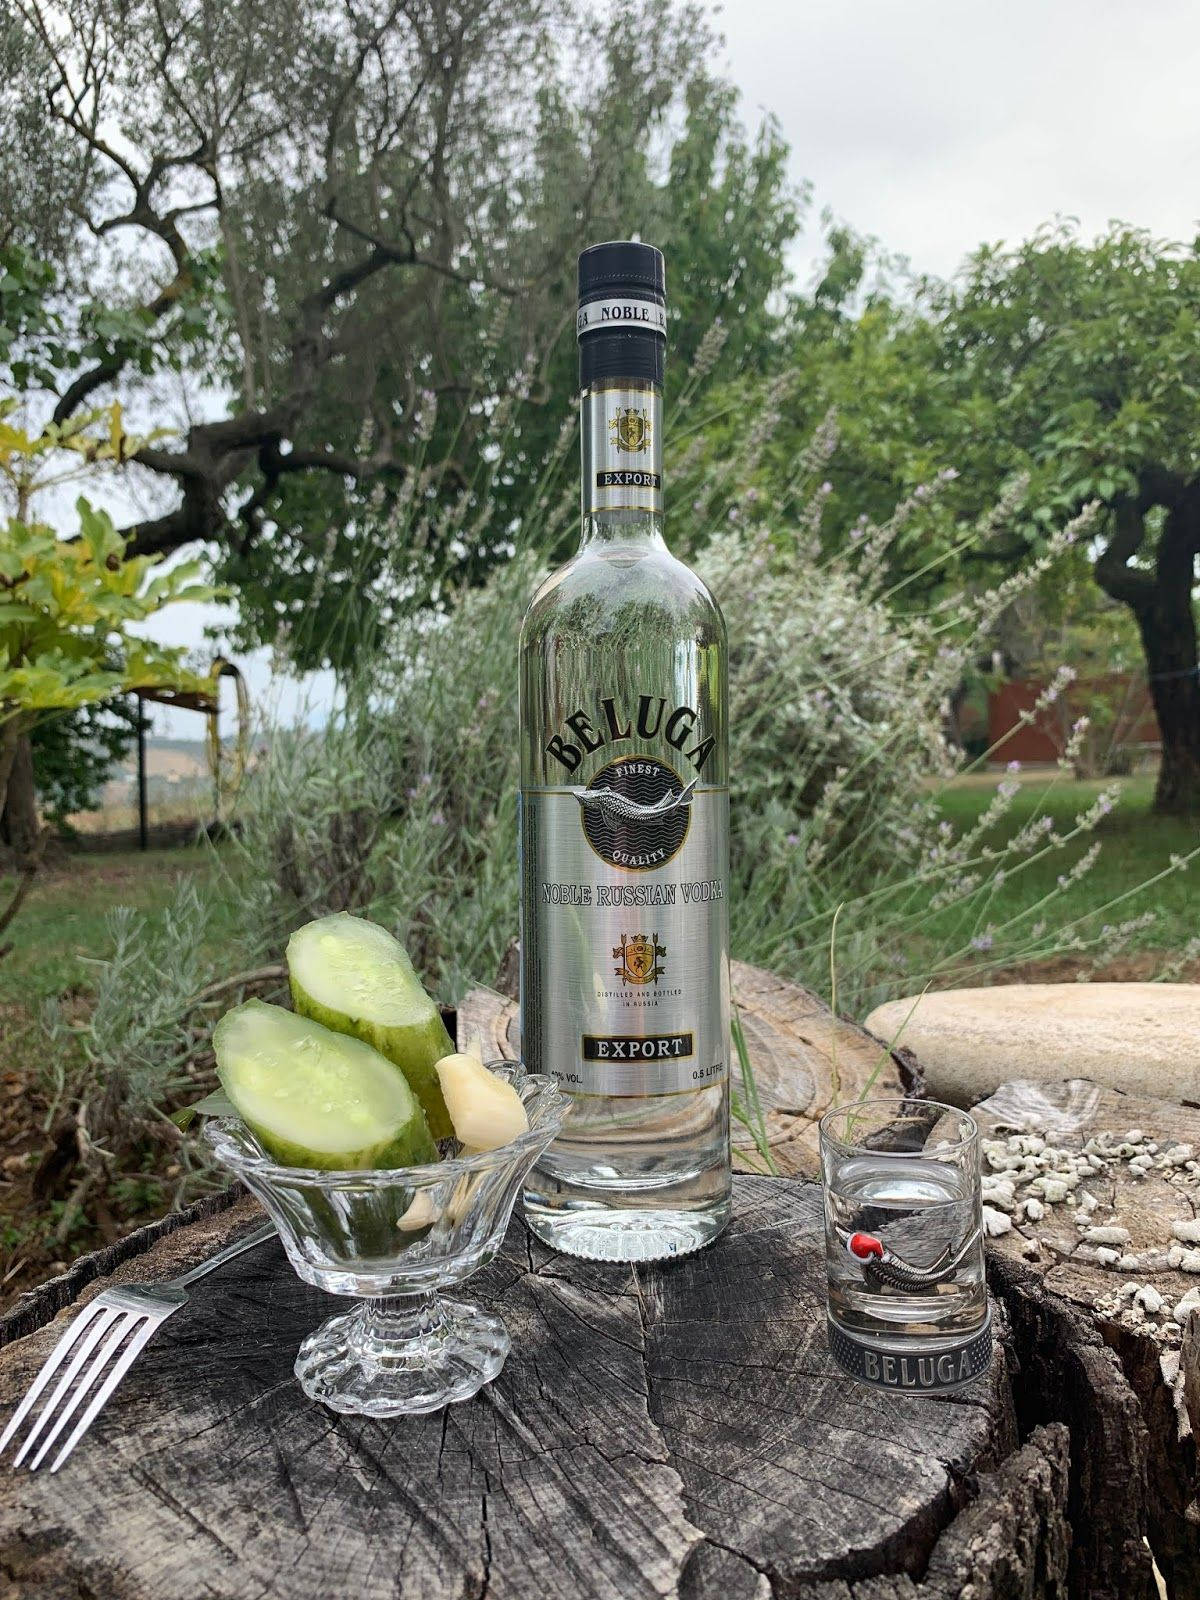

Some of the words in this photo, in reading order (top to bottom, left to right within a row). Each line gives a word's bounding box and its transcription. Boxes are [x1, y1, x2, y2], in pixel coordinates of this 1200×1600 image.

[601, 306, 650, 322] NOBLE
[604, 473, 657, 487] EXPORT
[545, 694, 717, 776] BELUGA
[616, 764, 661, 778] FINEST
[612, 848, 666, 865] QUALITY
[541, 883, 592, 906] NOBLE
[597, 884, 677, 906] RUSSIAN
[682, 879, 724, 903] VODKA
[653, 989, 682, 997] BOTTLED
[597, 1038, 683, 1058] EXPORT
[692, 1069, 704, 1080] 0.5
[706, 1062, 723, 1076] LITRE
[863, 1350, 973, 1388] BELUGA
